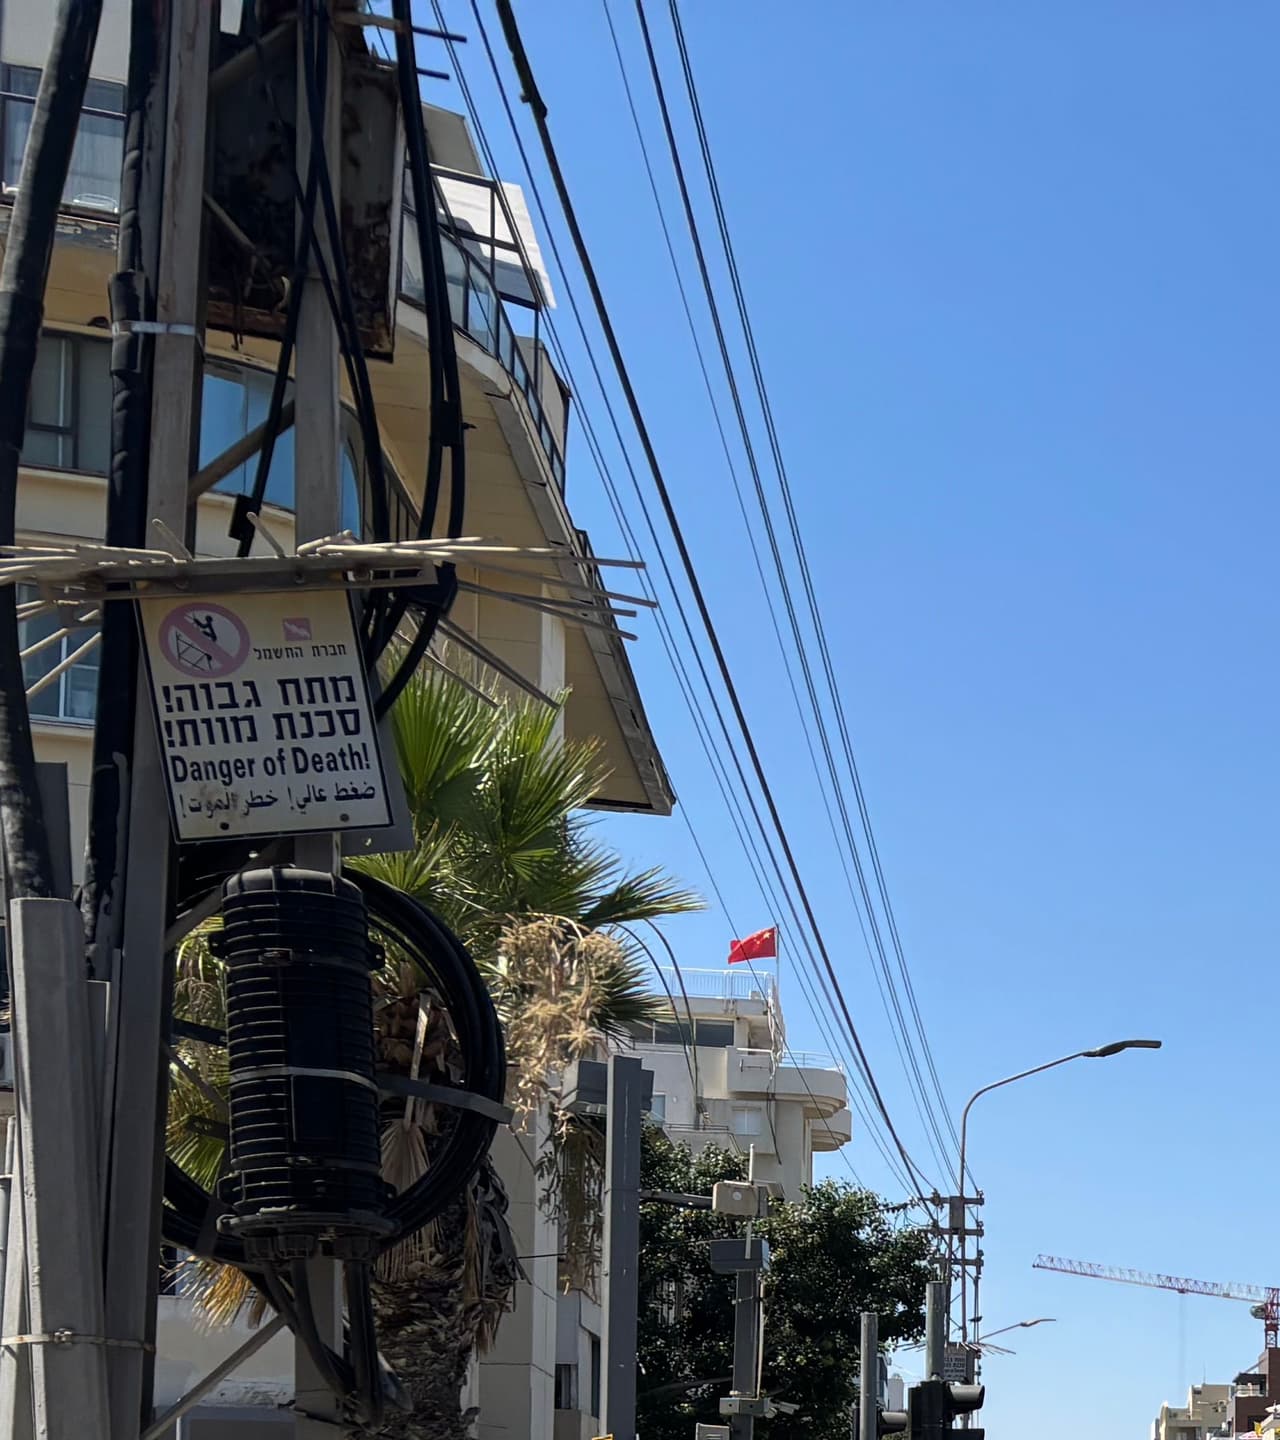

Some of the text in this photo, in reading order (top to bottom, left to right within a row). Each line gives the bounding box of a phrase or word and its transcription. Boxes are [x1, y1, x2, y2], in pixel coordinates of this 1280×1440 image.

[252, 643, 347, 661] חברת החשמל
[162, 675, 357, 713] מתח גבוה!
[164, 708, 361, 748] סכנת מוות!
[170, 742, 371, 787] Danger of Death!
